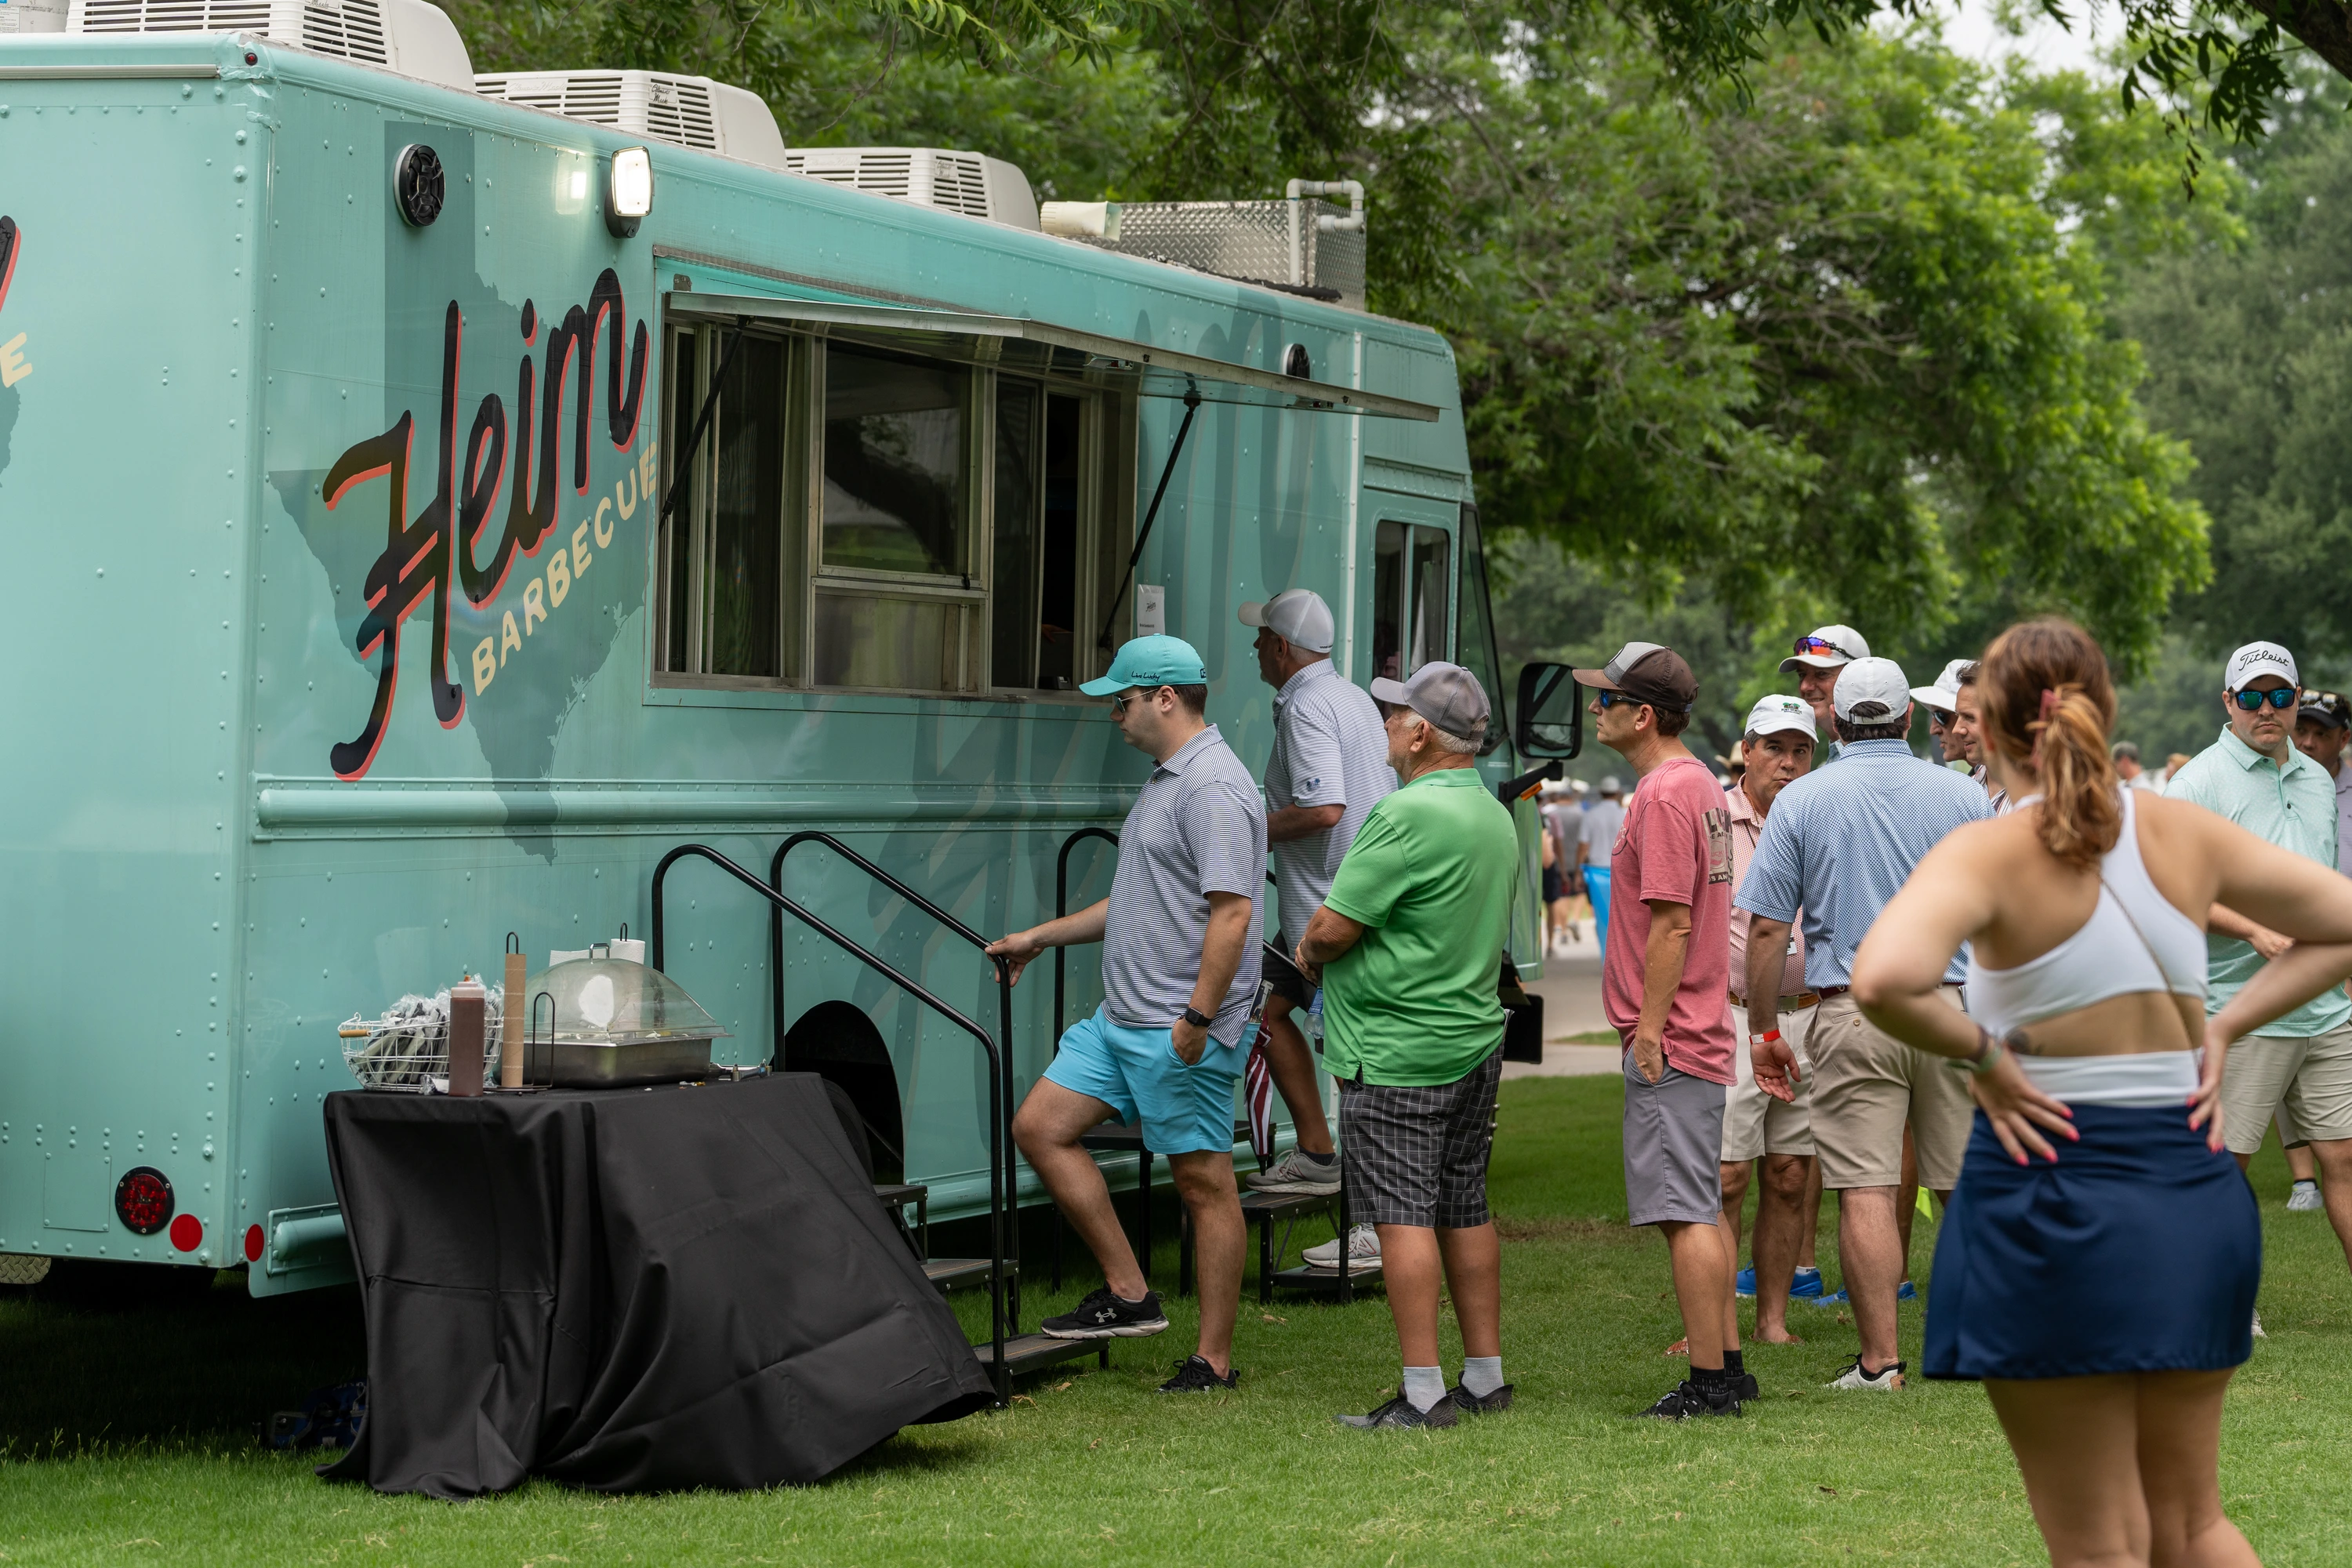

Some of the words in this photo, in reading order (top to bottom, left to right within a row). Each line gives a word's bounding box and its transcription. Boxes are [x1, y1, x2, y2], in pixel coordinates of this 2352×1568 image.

[322, 267, 650, 782] Heim
[472, 441, 657, 697] BARBECUE
[1131, 670, 1142, 679] Live
[1143, 672, 1160, 682] Lucky
[2238, 649, 2289, 671] Titleist
